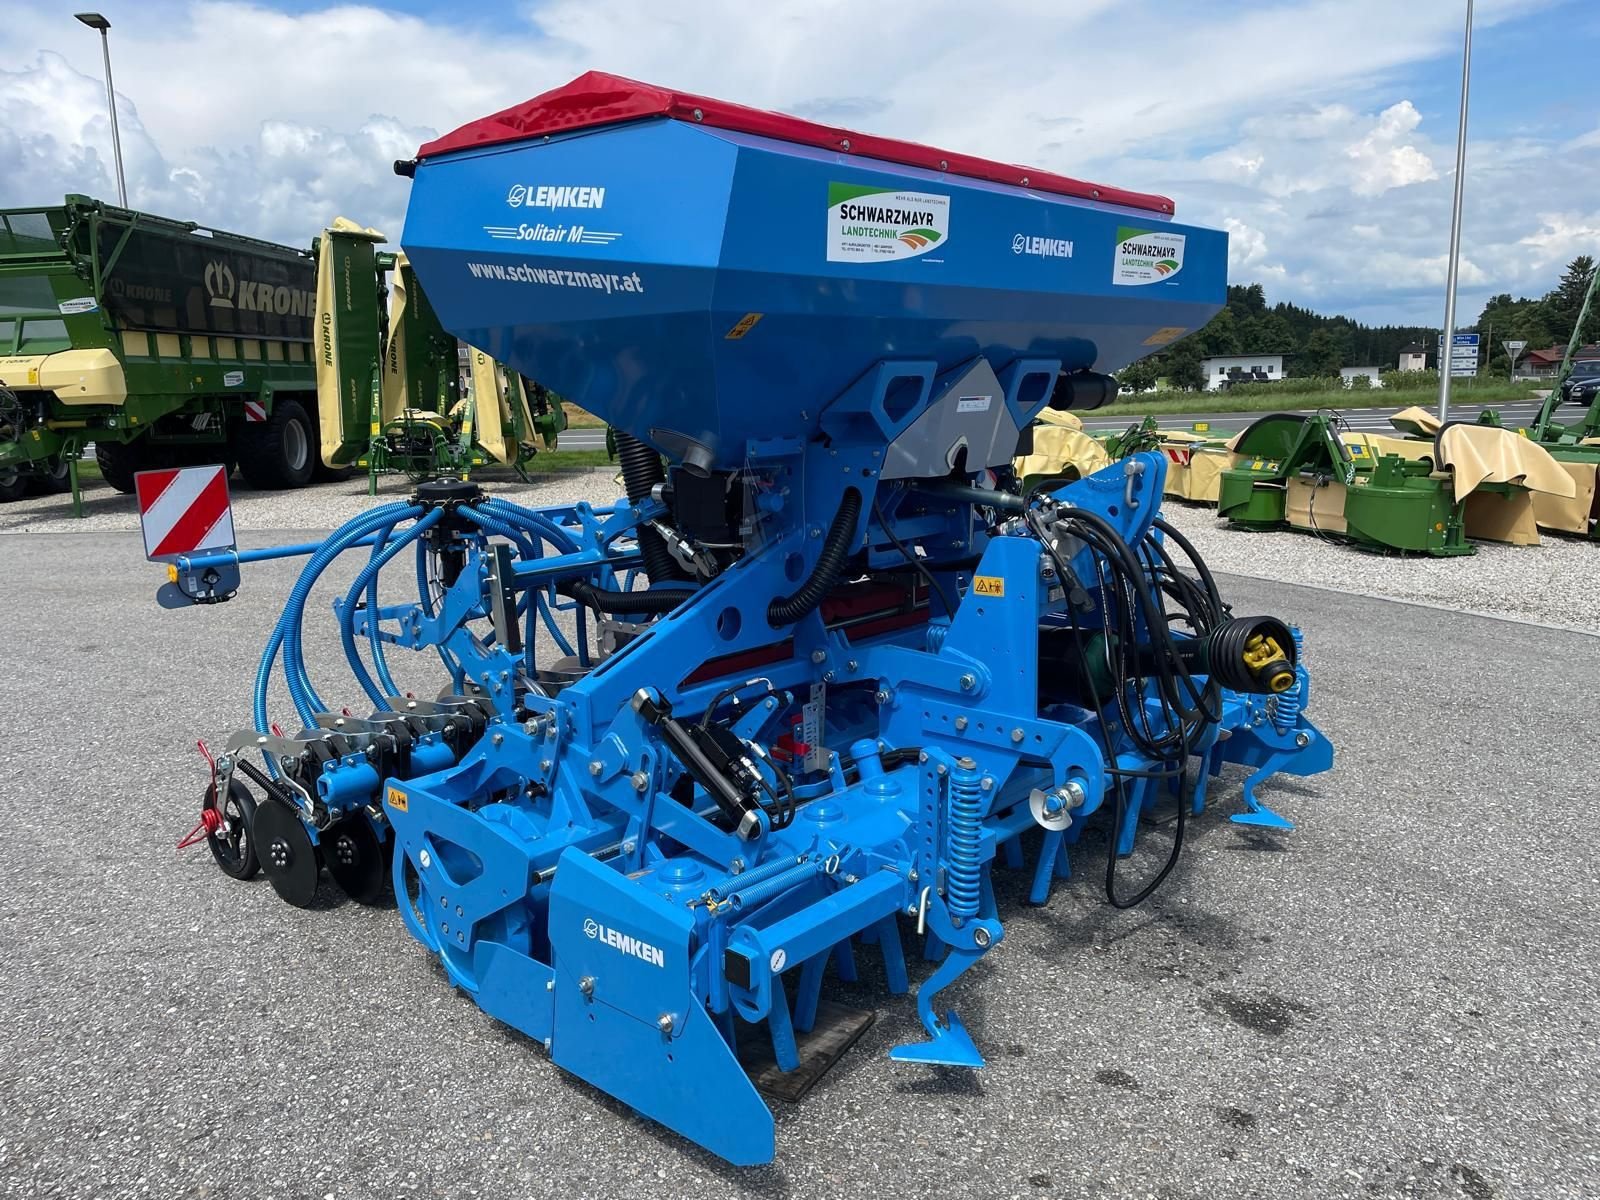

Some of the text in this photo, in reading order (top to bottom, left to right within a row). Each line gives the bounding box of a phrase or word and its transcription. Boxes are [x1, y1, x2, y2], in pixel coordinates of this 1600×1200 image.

[525, 186, 606, 212] LEMKEN
[840, 203, 934, 226] SCHWARZMAYR
[516, 223, 584, 243] Solitair M
[841, 225, 898, 240] LANDTECHNIK
[1025, 236, 1073, 260] LEMKEN
[1122, 242, 1176, 259] SCHWARZMAYR
[1122, 258, 1154, 268] LANDTECHNIK
[467, 263, 643, 293] www.schwarzmayr.at
[126, 285, 172, 302] KRONE
[238, 280, 317, 318] KRONE
[322, 325, 333, 368] KRONE
[599, 924, 664, 968] LEMKEN
